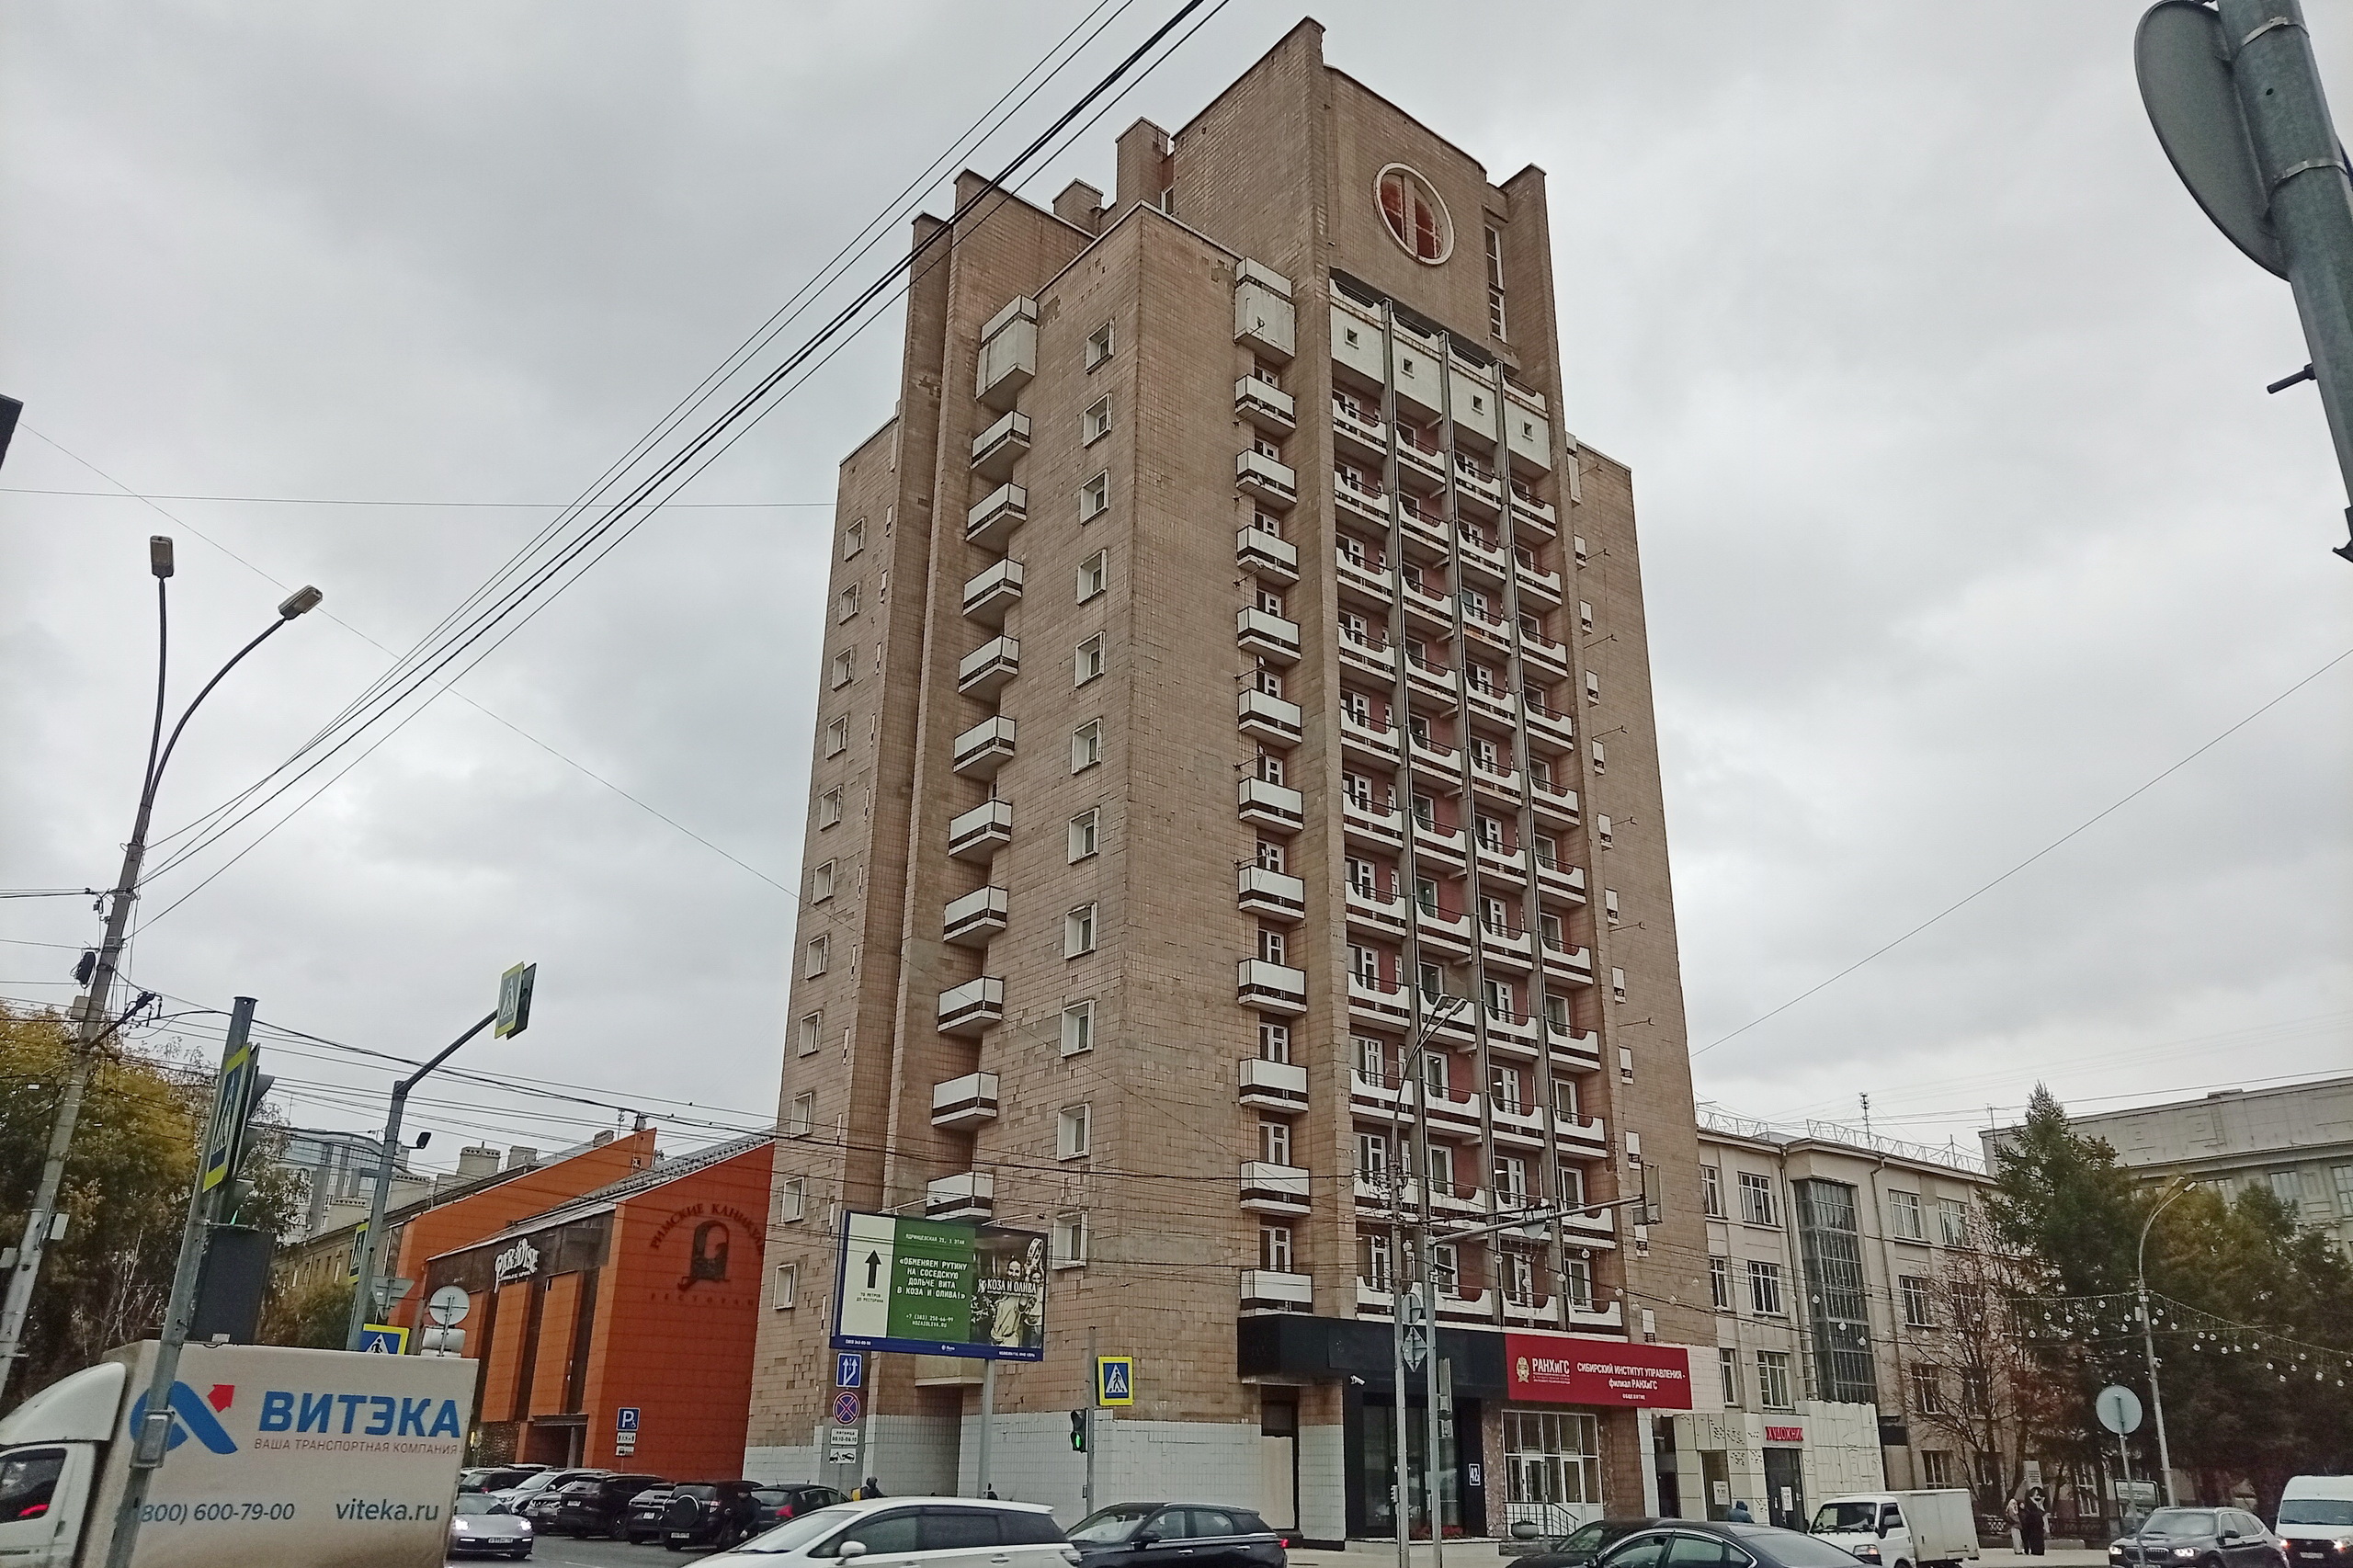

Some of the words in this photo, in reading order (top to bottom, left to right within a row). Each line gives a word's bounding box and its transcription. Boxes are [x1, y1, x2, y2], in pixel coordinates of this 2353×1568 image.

[650, 1203, 704, 1250] РИМСКИЕ
[899, 1256, 938, 1268] «ОБМЕНЯЕМ
[941, 1261, 968, 1271] РУТИНУ
[907, 1267, 916, 1276] НА
[919, 1268, 959, 1279] СОСЕДСКУЮ
[908, 1278, 935, 1287] ДОЛЬЧЕ
[938, 1280, 956, 1289] ВИТА
[987, 1278, 1006, 1291] КОЗА
[1006, 1280, 1013, 1291] И
[1013, 1281, 1037, 1294] ОЛИВА
[896, 1286, 903, 1294] В
[905, 1287, 924, 1296] КОЗА
[935, 1290, 966, 1300] ОЛИВА!»
[1531, 1358, 1570, 1375] РАНХиГС
[1576, 1362, 1614, 1375] СИБИРСКИЙ
[1614, 1365, 1644, 1377] ИНСТИТУТ
[1644, 1368, 1683, 1380] УПРАВЛЕНИЯ
[1608, 1378, 1631, 1390] филиал
[1631, 1379, 1658, 1390] РАНХиГС
[258, 1391, 460, 1438] ВИТЭКА
[621, 1411, 634, 1427] P
[254, 1438, 290, 1450] ВАША
[295, 1439, 390, 1452] ТРАНСПОРТНАЯ
[393, 1442, 459, 1455] КОМПАНИЯ
[141, 1504, 188, 1526] 800)
[194, 1503, 295, 1521] 600-79-00
[335, 1498, 439, 1521] viteka.ru
